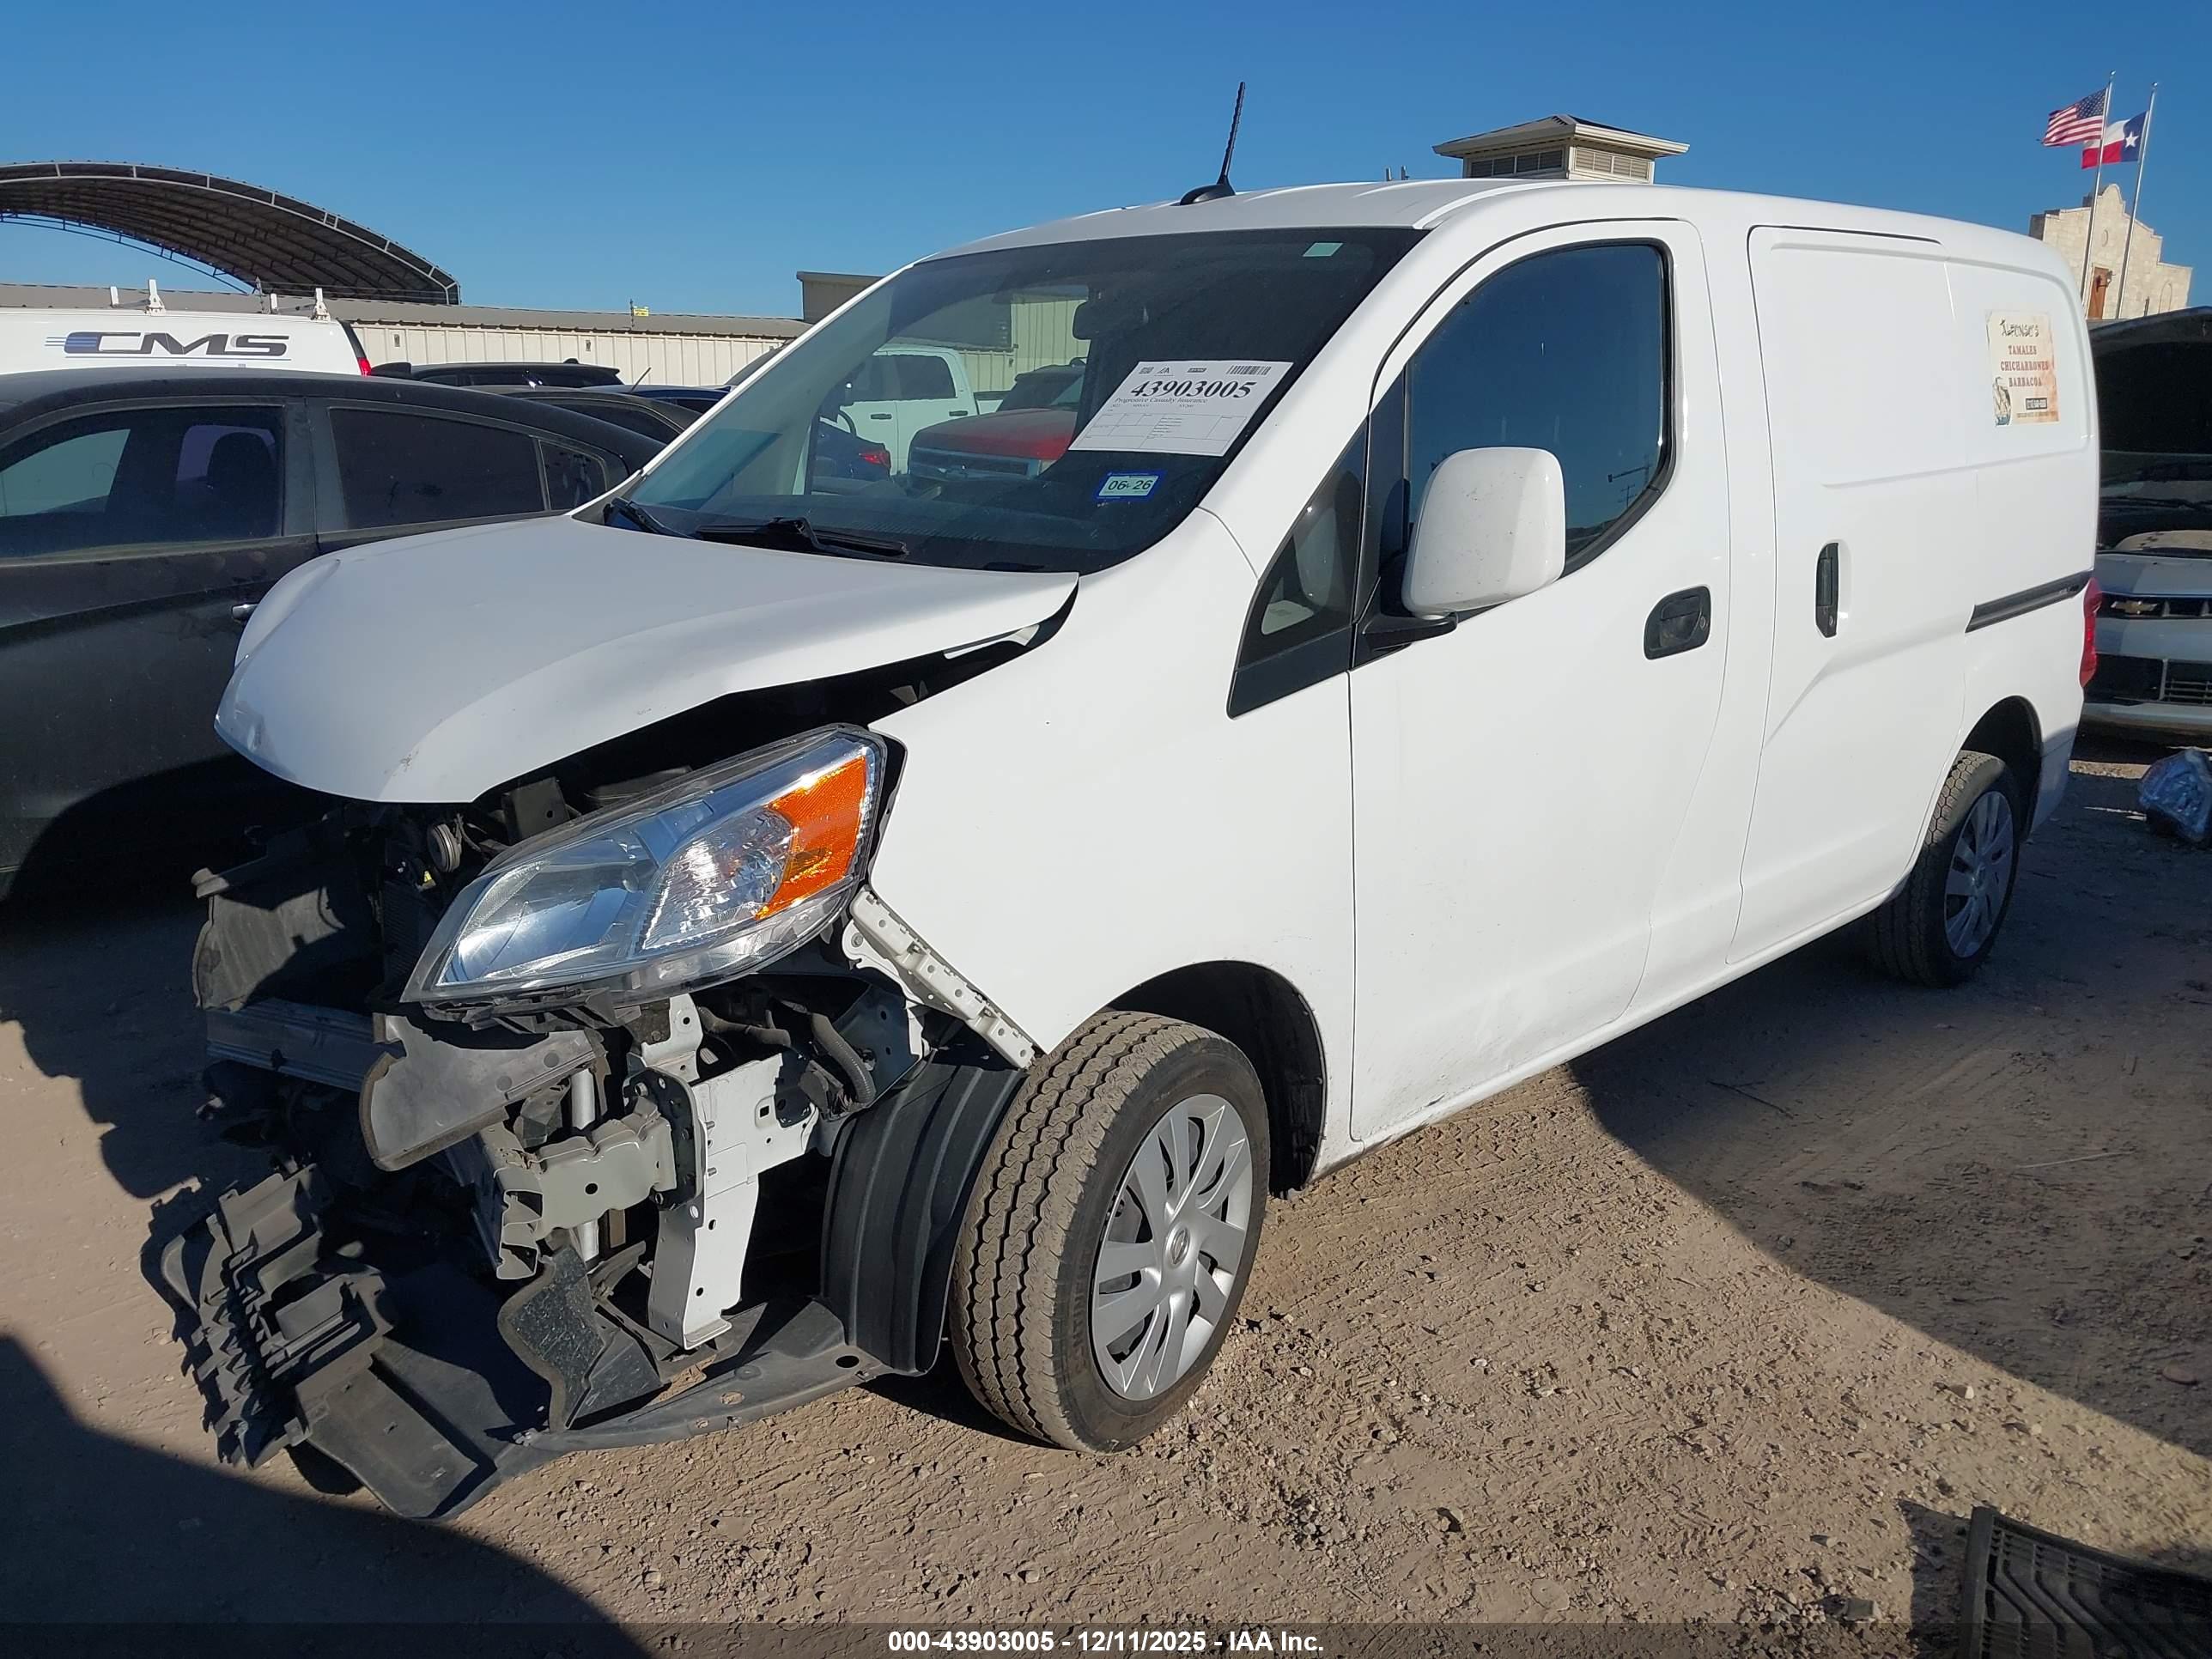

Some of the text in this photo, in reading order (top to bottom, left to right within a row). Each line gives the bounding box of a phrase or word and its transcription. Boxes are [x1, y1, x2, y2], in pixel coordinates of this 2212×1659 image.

[64, 331, 289, 357] CMS
[2008, 345, 2037, 355] TAMALES
[2000, 361, 2050, 371] CHICHARRONES
[2008, 377, 2043, 387] BARBACOA
[1131, 380, 1257, 398] 43903005
